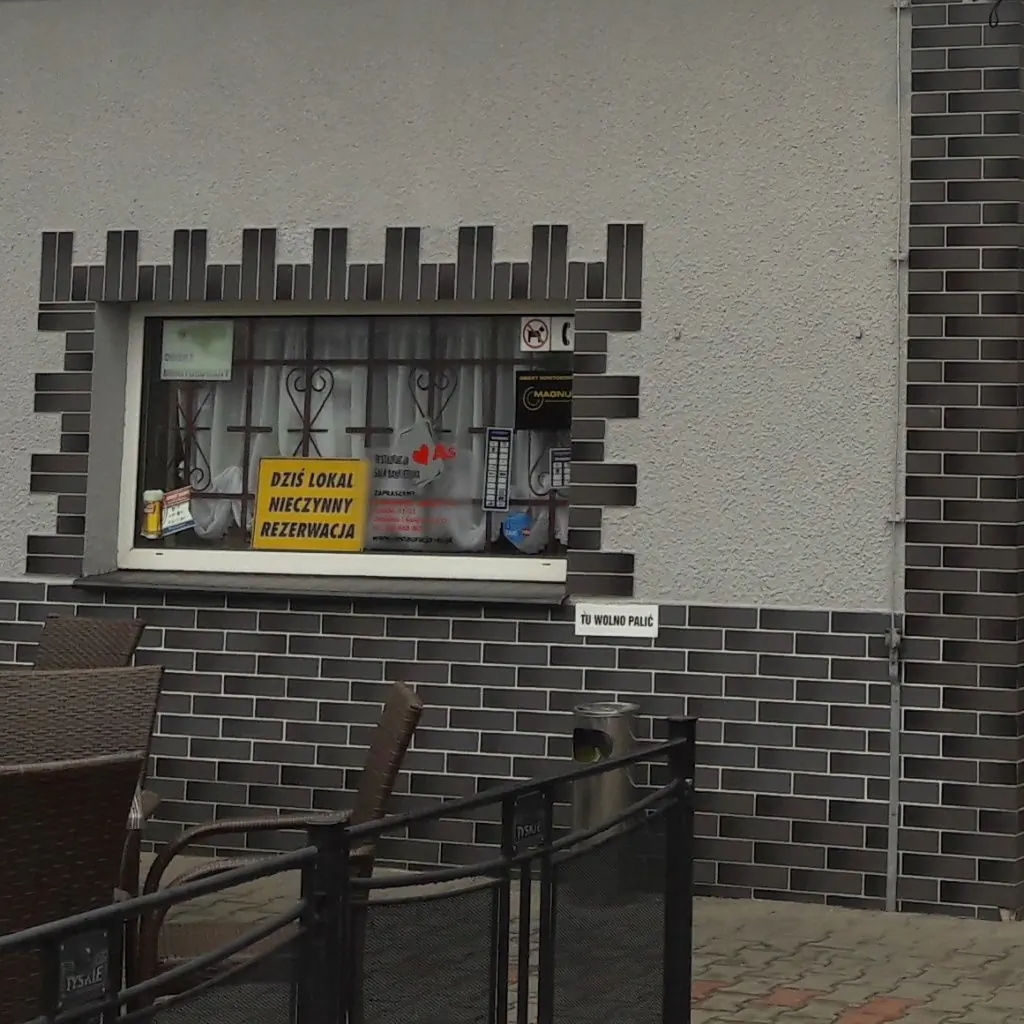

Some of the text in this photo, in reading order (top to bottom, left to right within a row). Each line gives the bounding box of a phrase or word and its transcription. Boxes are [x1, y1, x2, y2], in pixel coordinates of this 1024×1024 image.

[270, 467, 354, 489] DZIŚ LOKAL
[268, 496, 354, 514] NIECZYNNY
[260, 521, 356, 539] REZERWACJA
[580, 611, 654, 628] TU WOLNO PALIĆ
